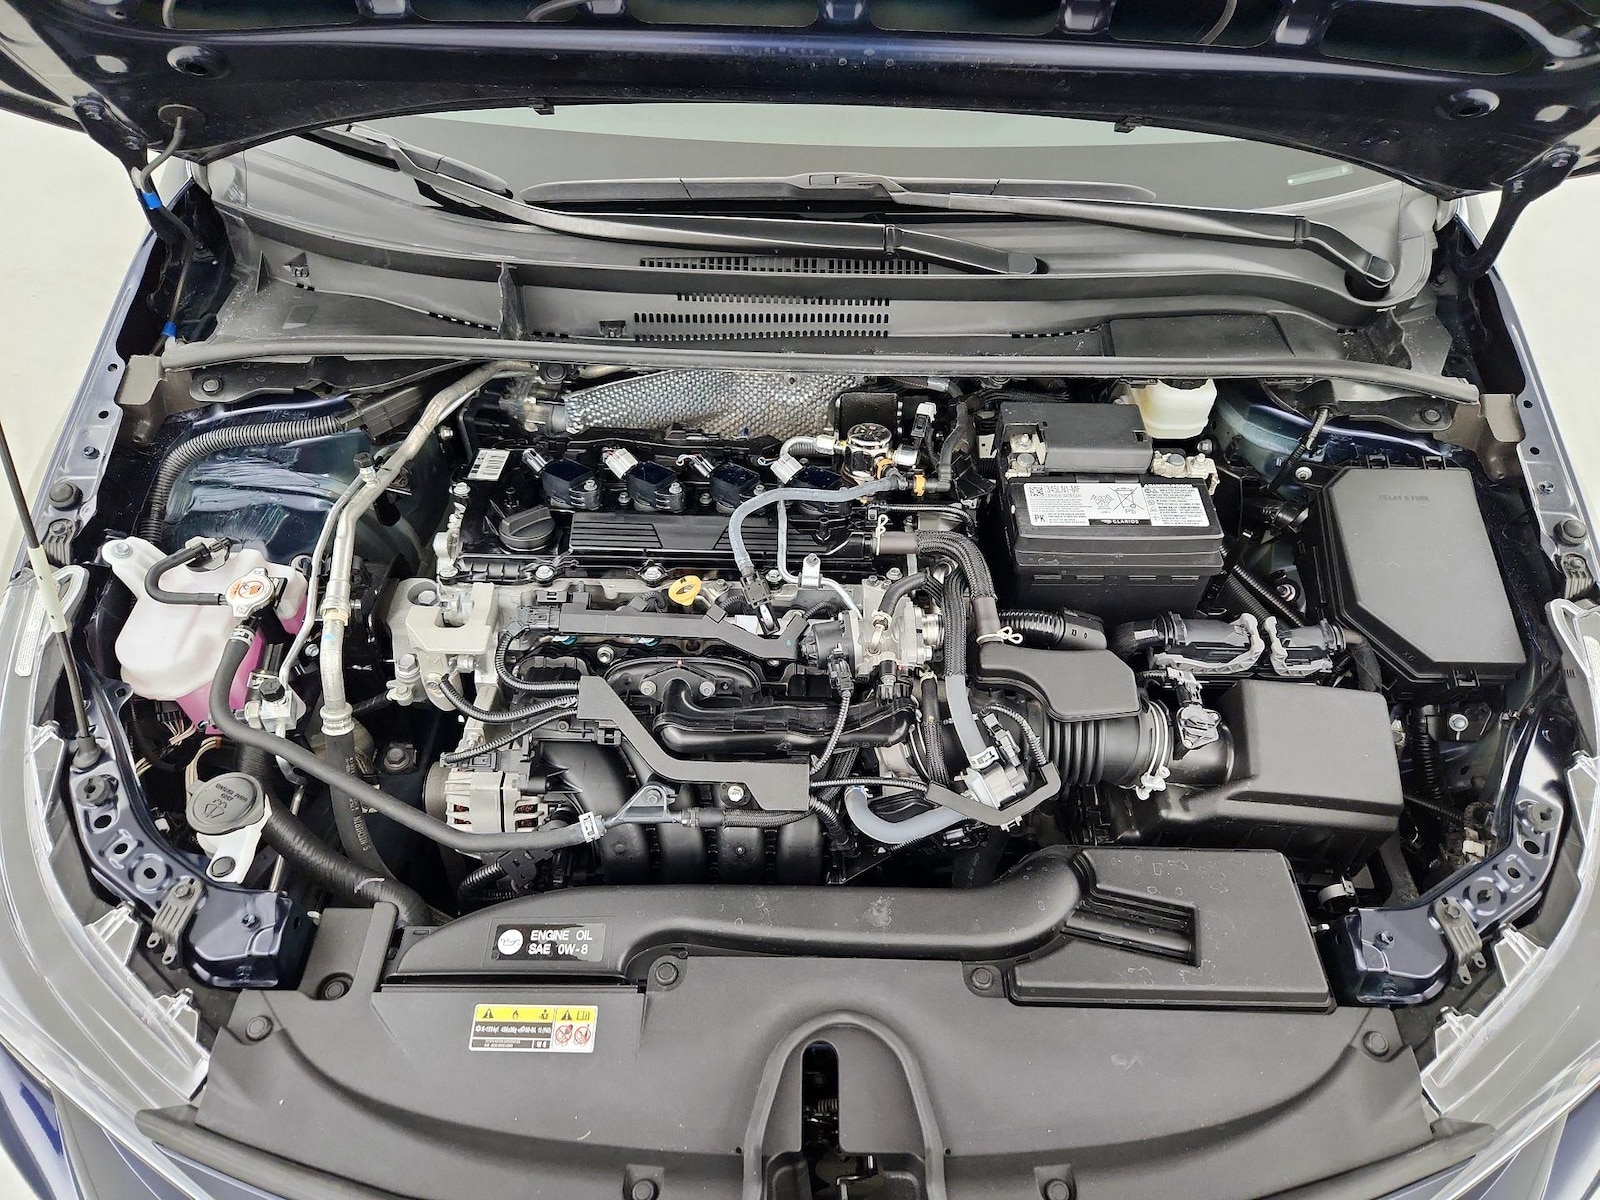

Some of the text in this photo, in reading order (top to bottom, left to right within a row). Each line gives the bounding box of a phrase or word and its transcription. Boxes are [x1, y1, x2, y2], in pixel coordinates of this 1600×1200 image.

[1034, 514, 1046, 522] PK
[530, 929, 593, 941] ENGINE OIL
[528, 943, 589, 955] SAE 0W-8
